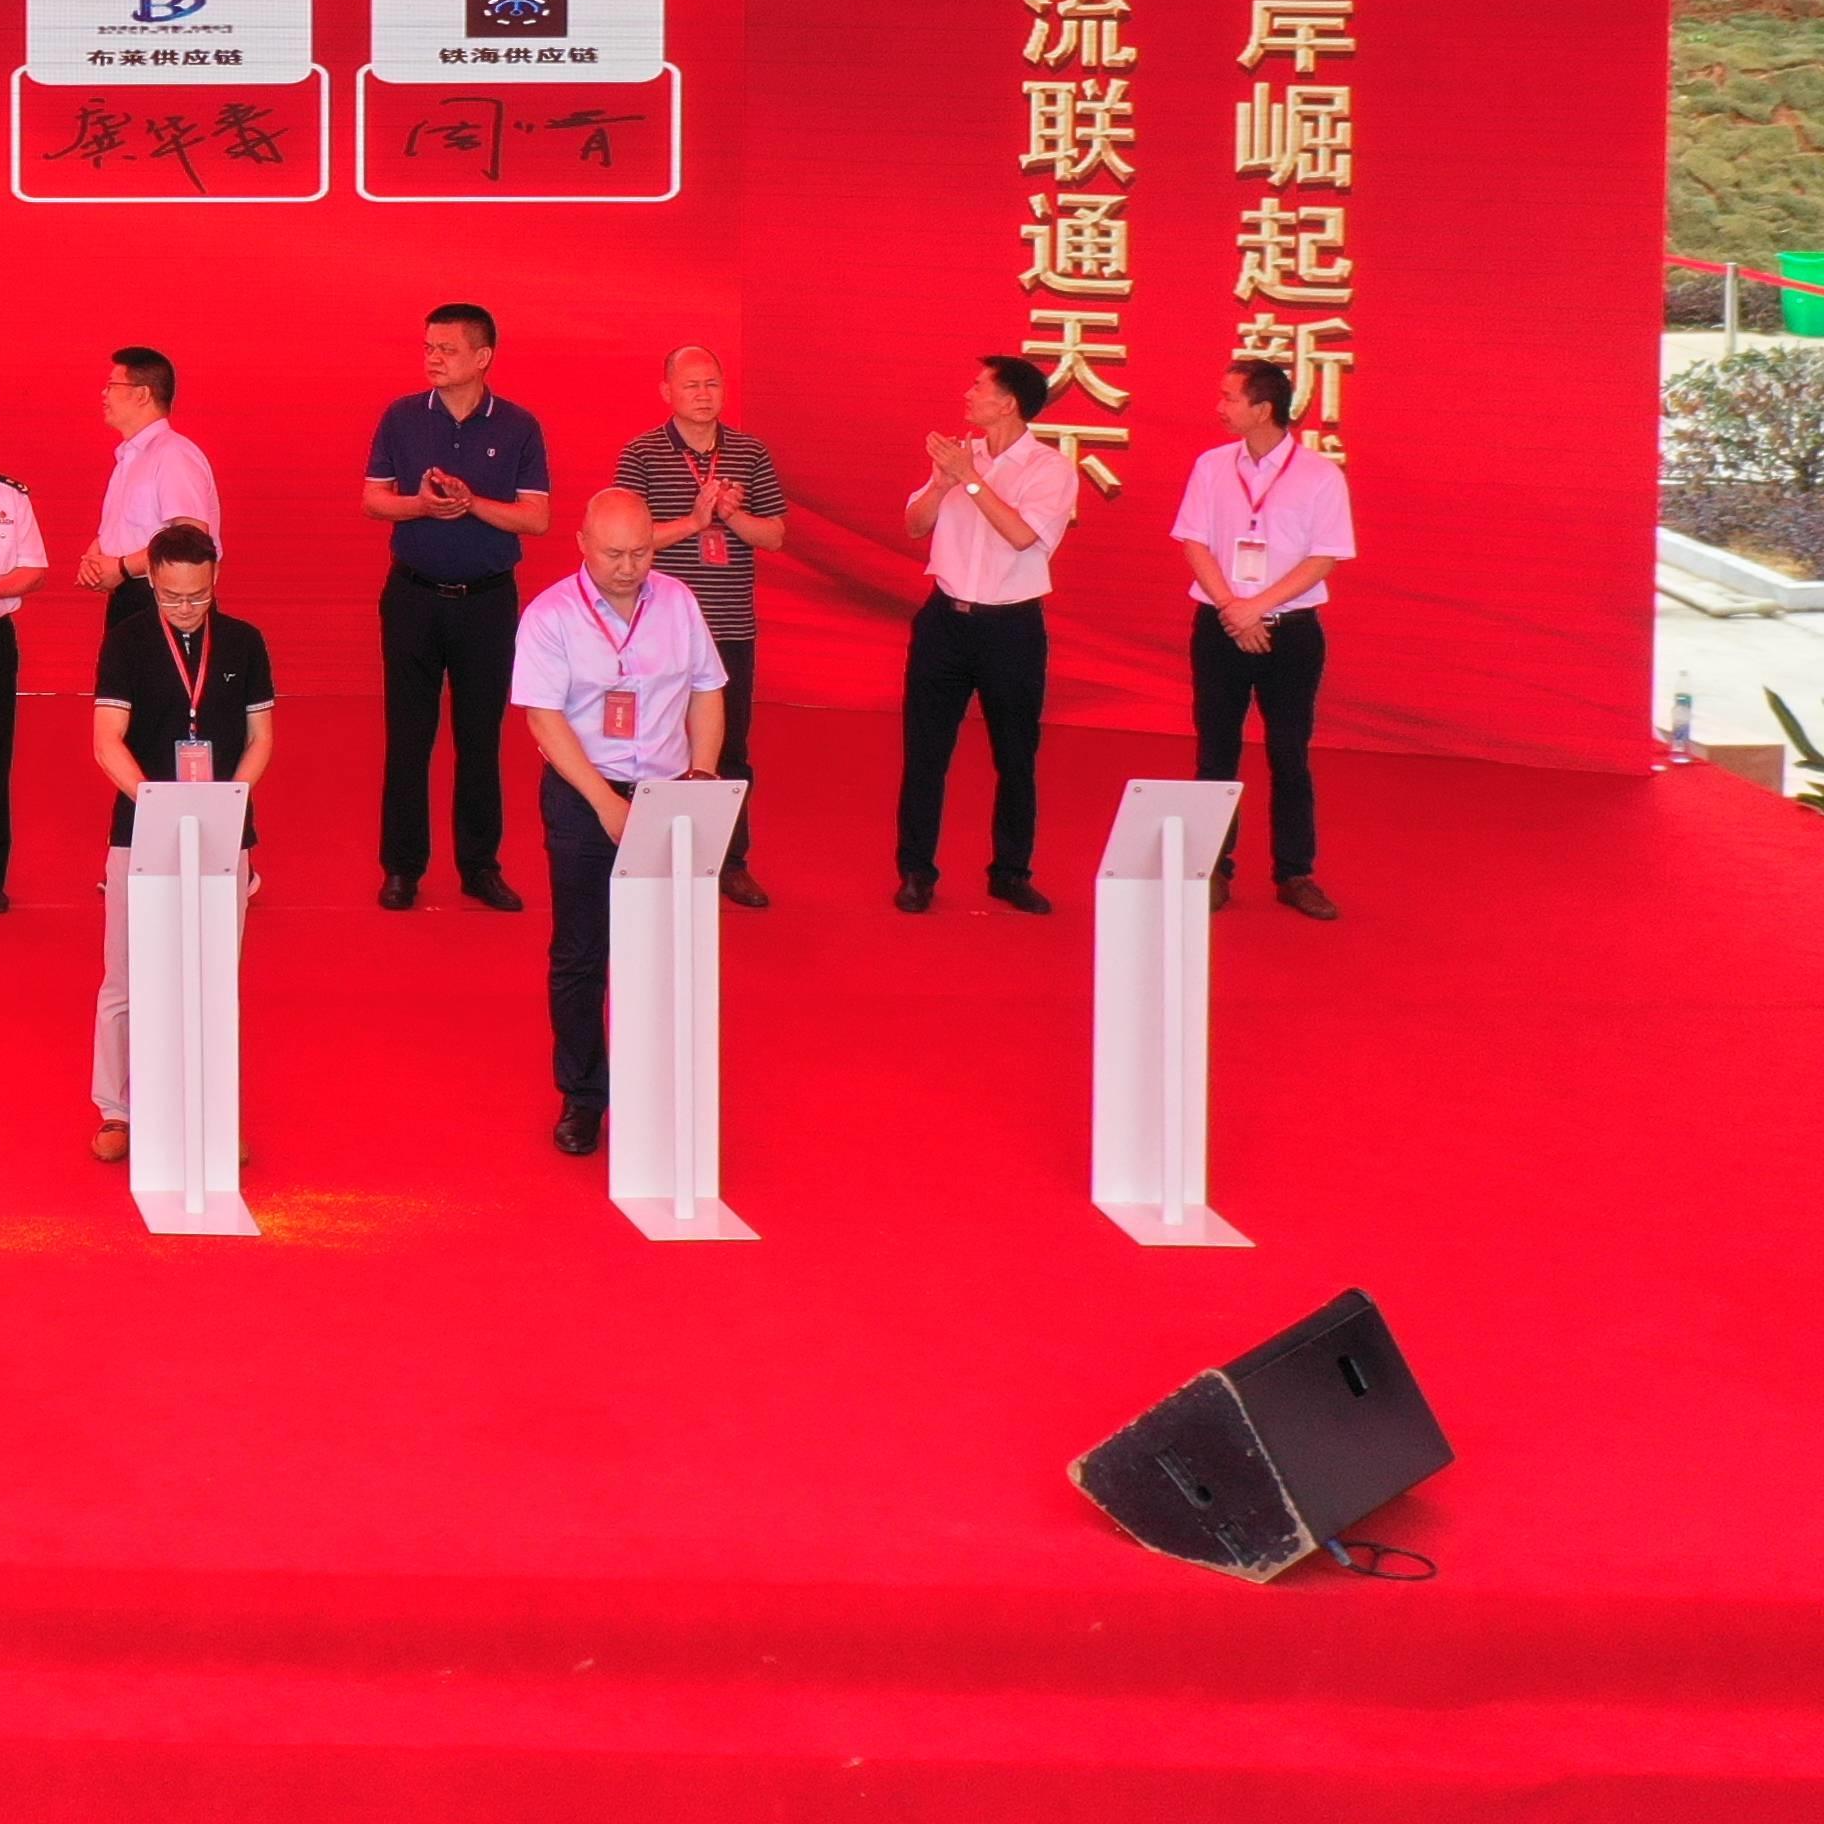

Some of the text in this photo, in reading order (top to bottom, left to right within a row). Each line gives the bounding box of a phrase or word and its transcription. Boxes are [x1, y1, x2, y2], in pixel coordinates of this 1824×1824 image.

[438, 47, 600, 64] 铁海供应链
